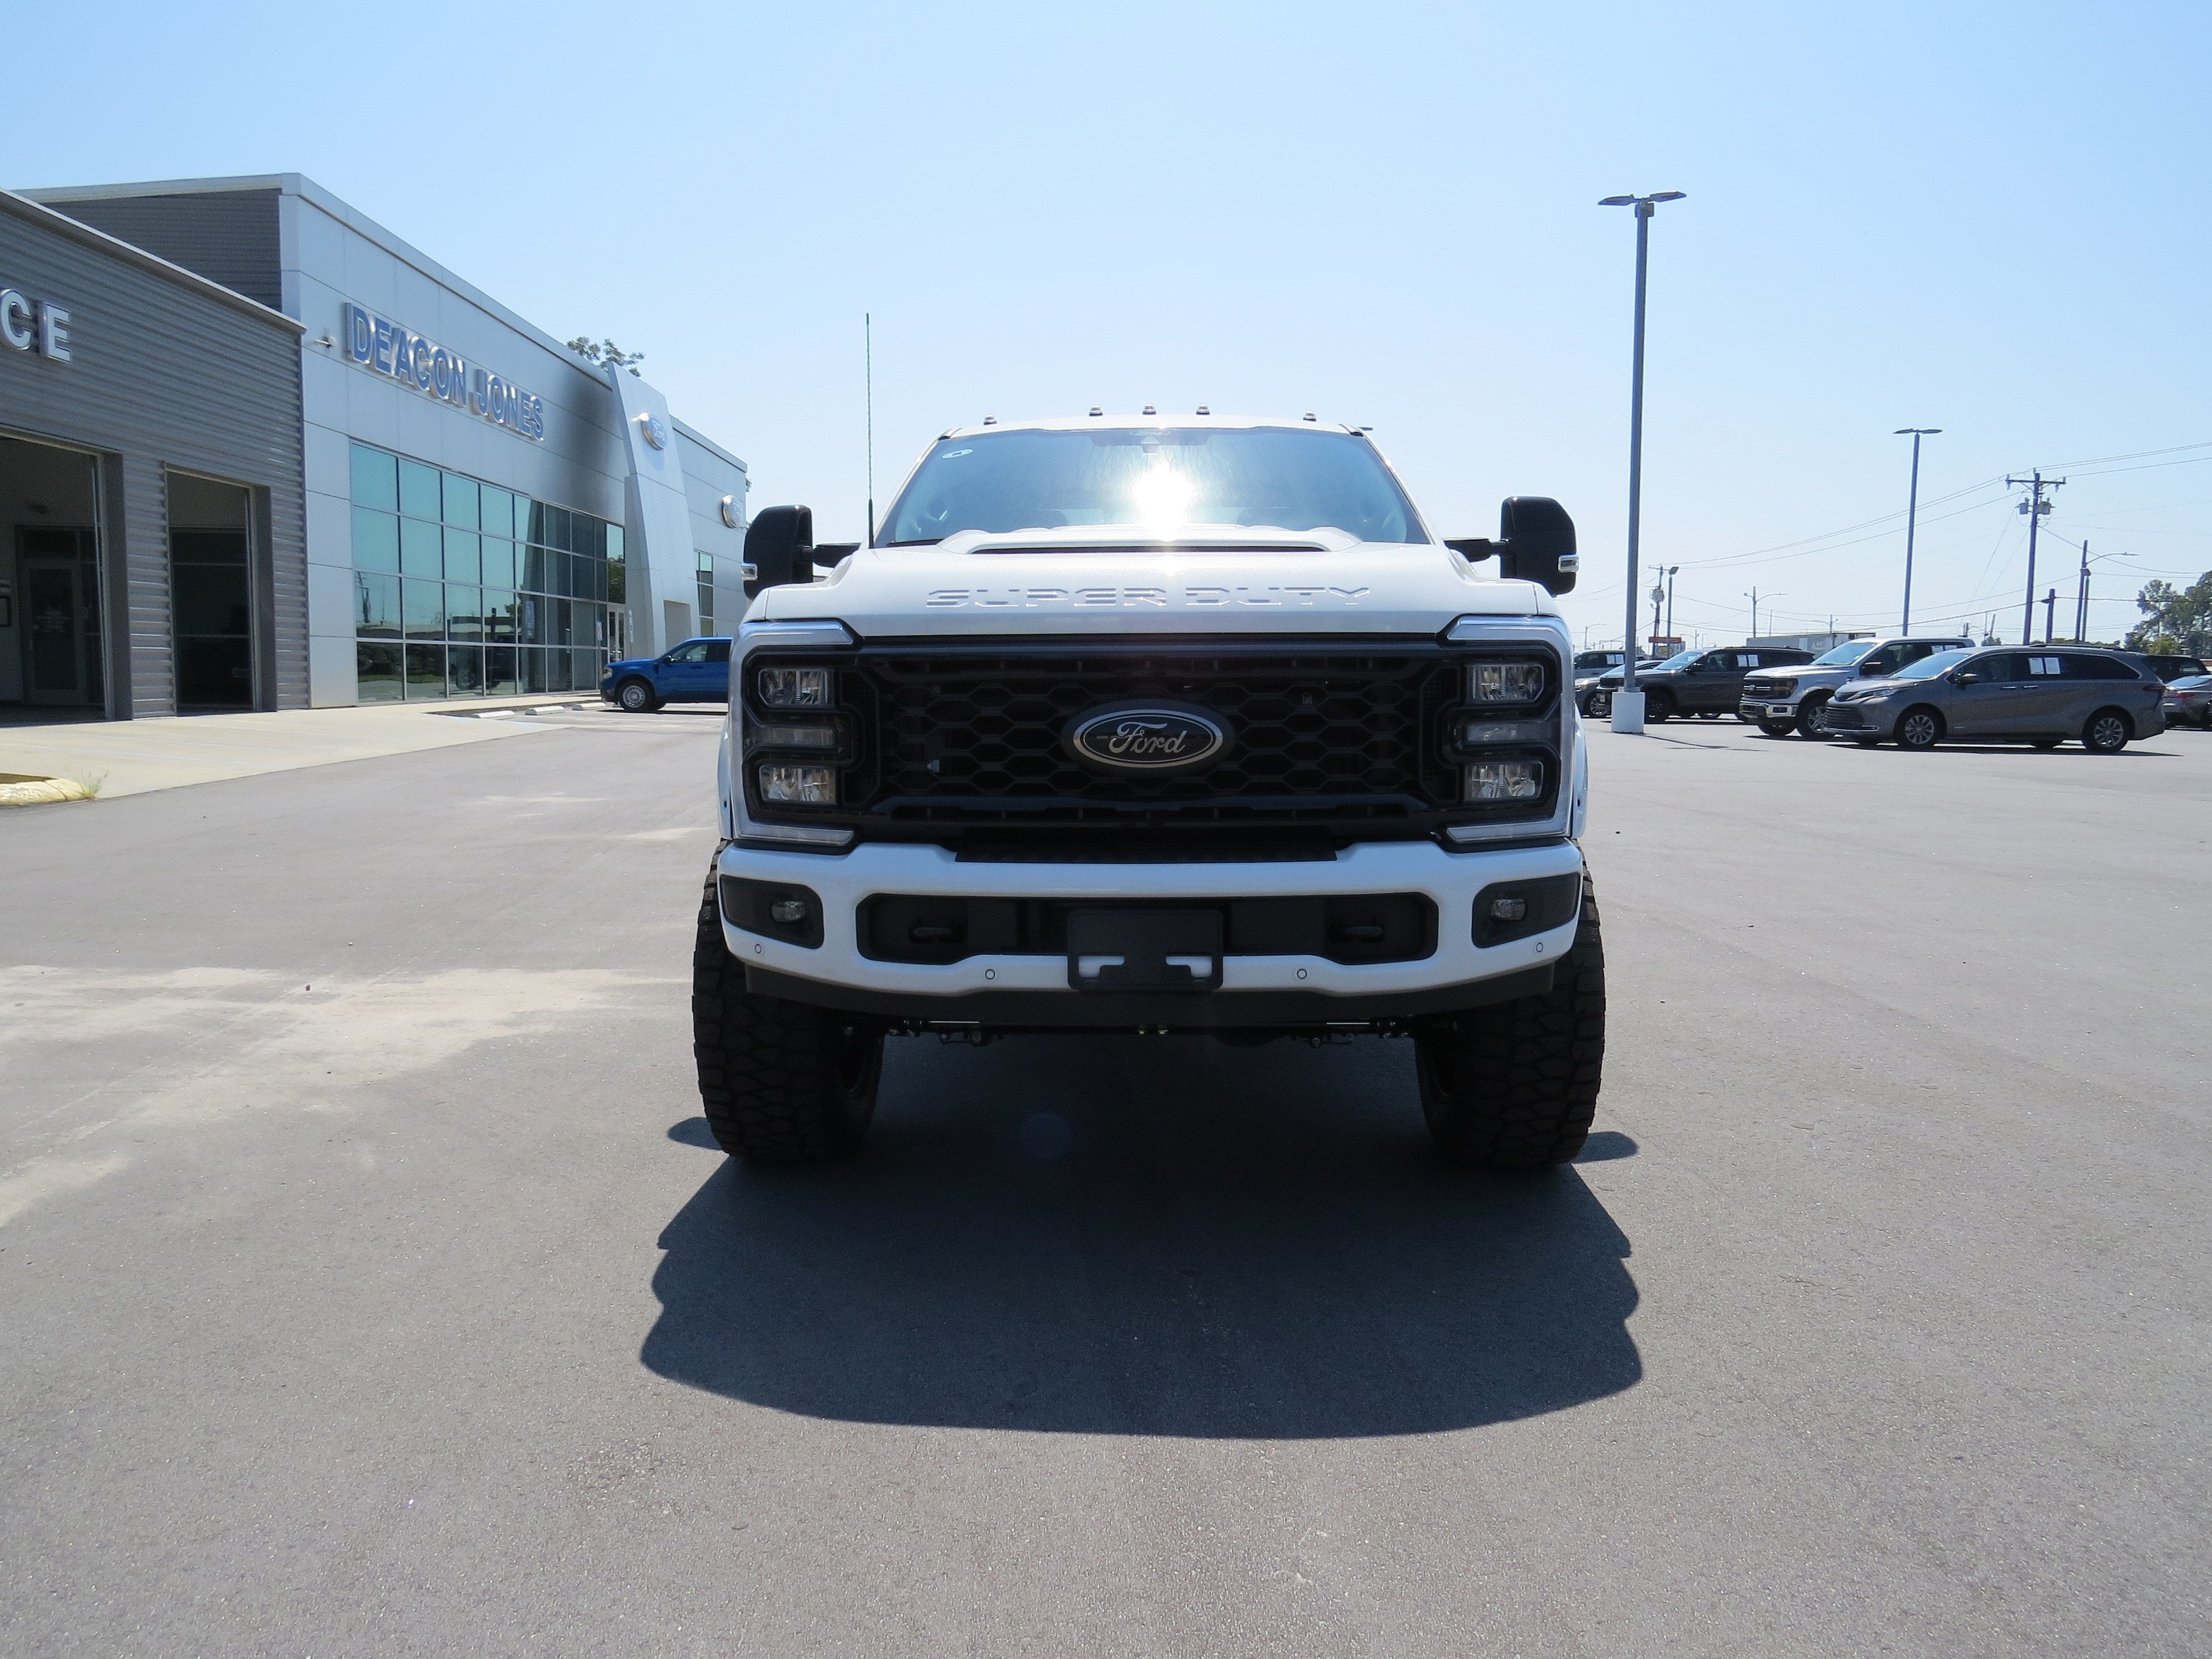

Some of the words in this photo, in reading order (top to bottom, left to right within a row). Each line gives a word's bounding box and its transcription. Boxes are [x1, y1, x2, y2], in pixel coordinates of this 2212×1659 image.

[0, 289, 71, 363] CE
[346, 302, 467, 408] DEACON
[471, 369, 544, 441] JONES
[926, 587, 1167, 608] SUPER
[1185, 587, 1370, 606] DUTY
[1108, 721, 1188, 754] Ford
